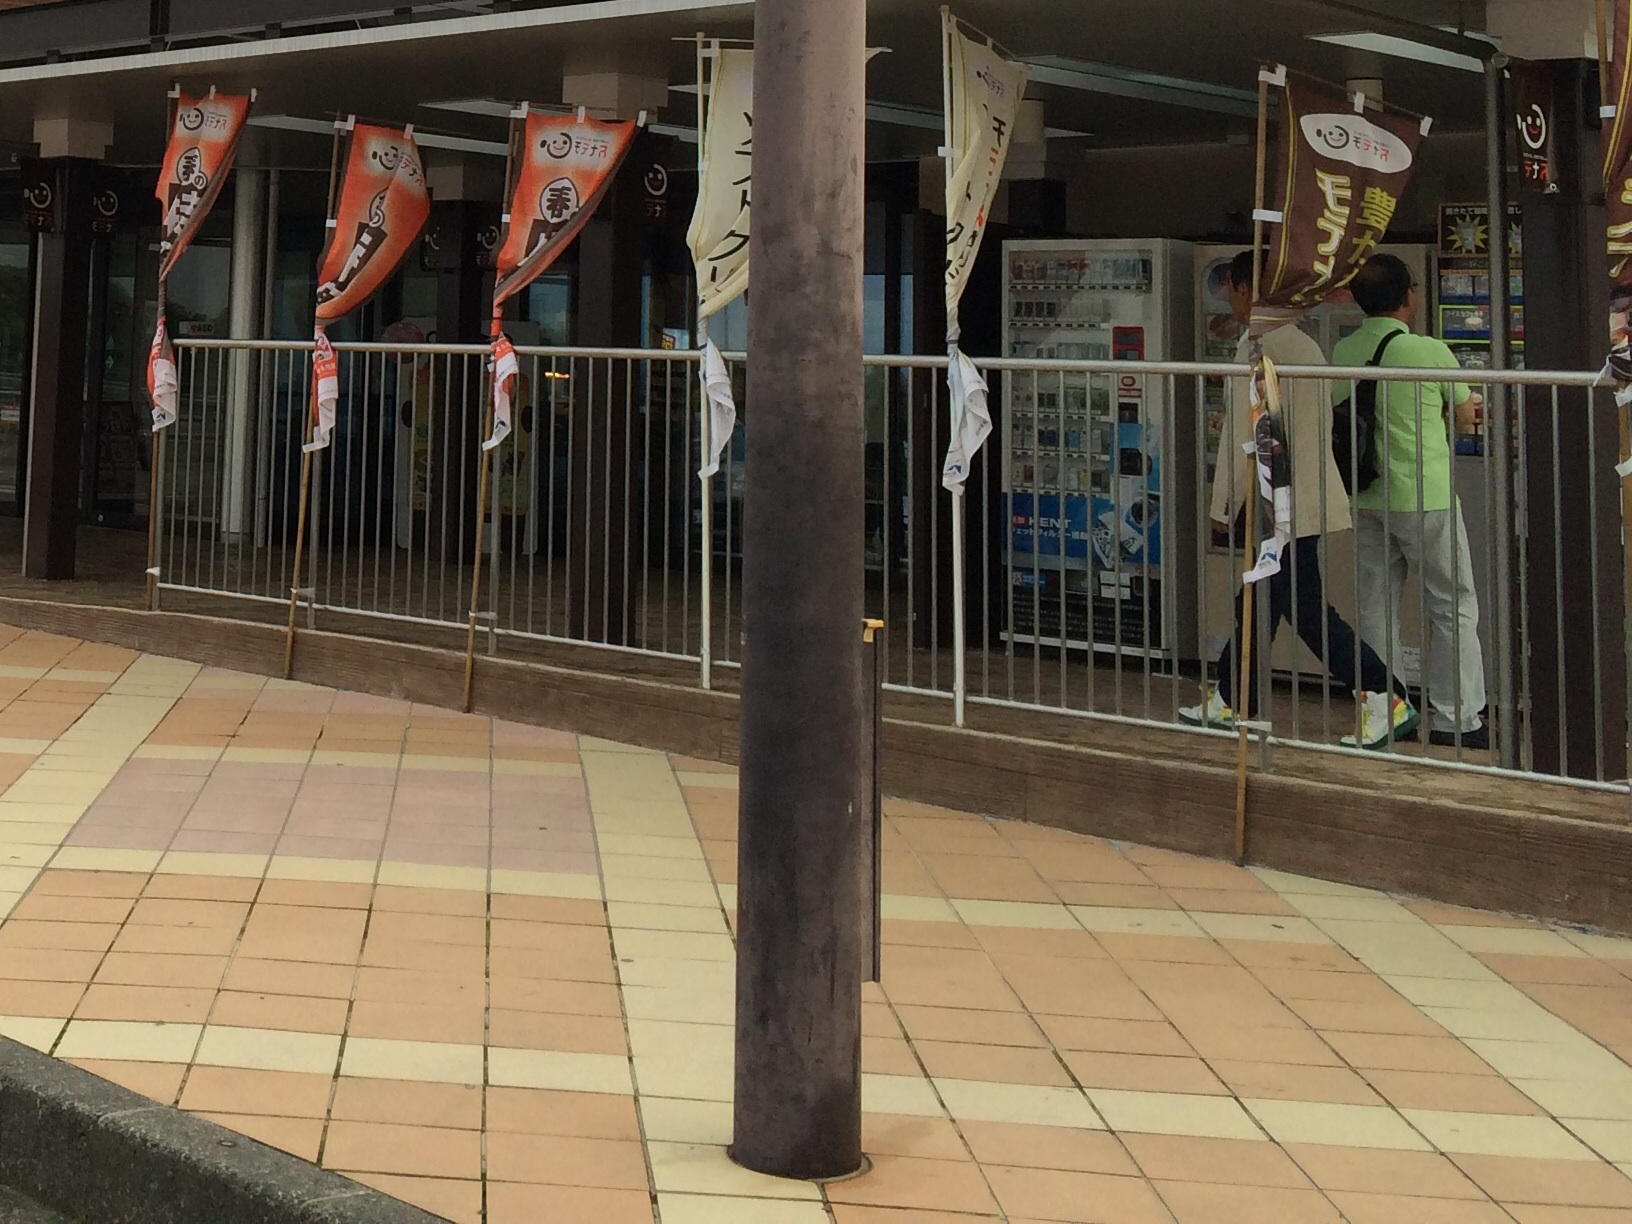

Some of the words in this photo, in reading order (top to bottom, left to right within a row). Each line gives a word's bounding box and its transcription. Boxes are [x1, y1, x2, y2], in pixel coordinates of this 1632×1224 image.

[574, 140, 609, 159] モテナス
[1352, 134, 1391, 163] モテナス
[546, 185, 573, 219] 春
